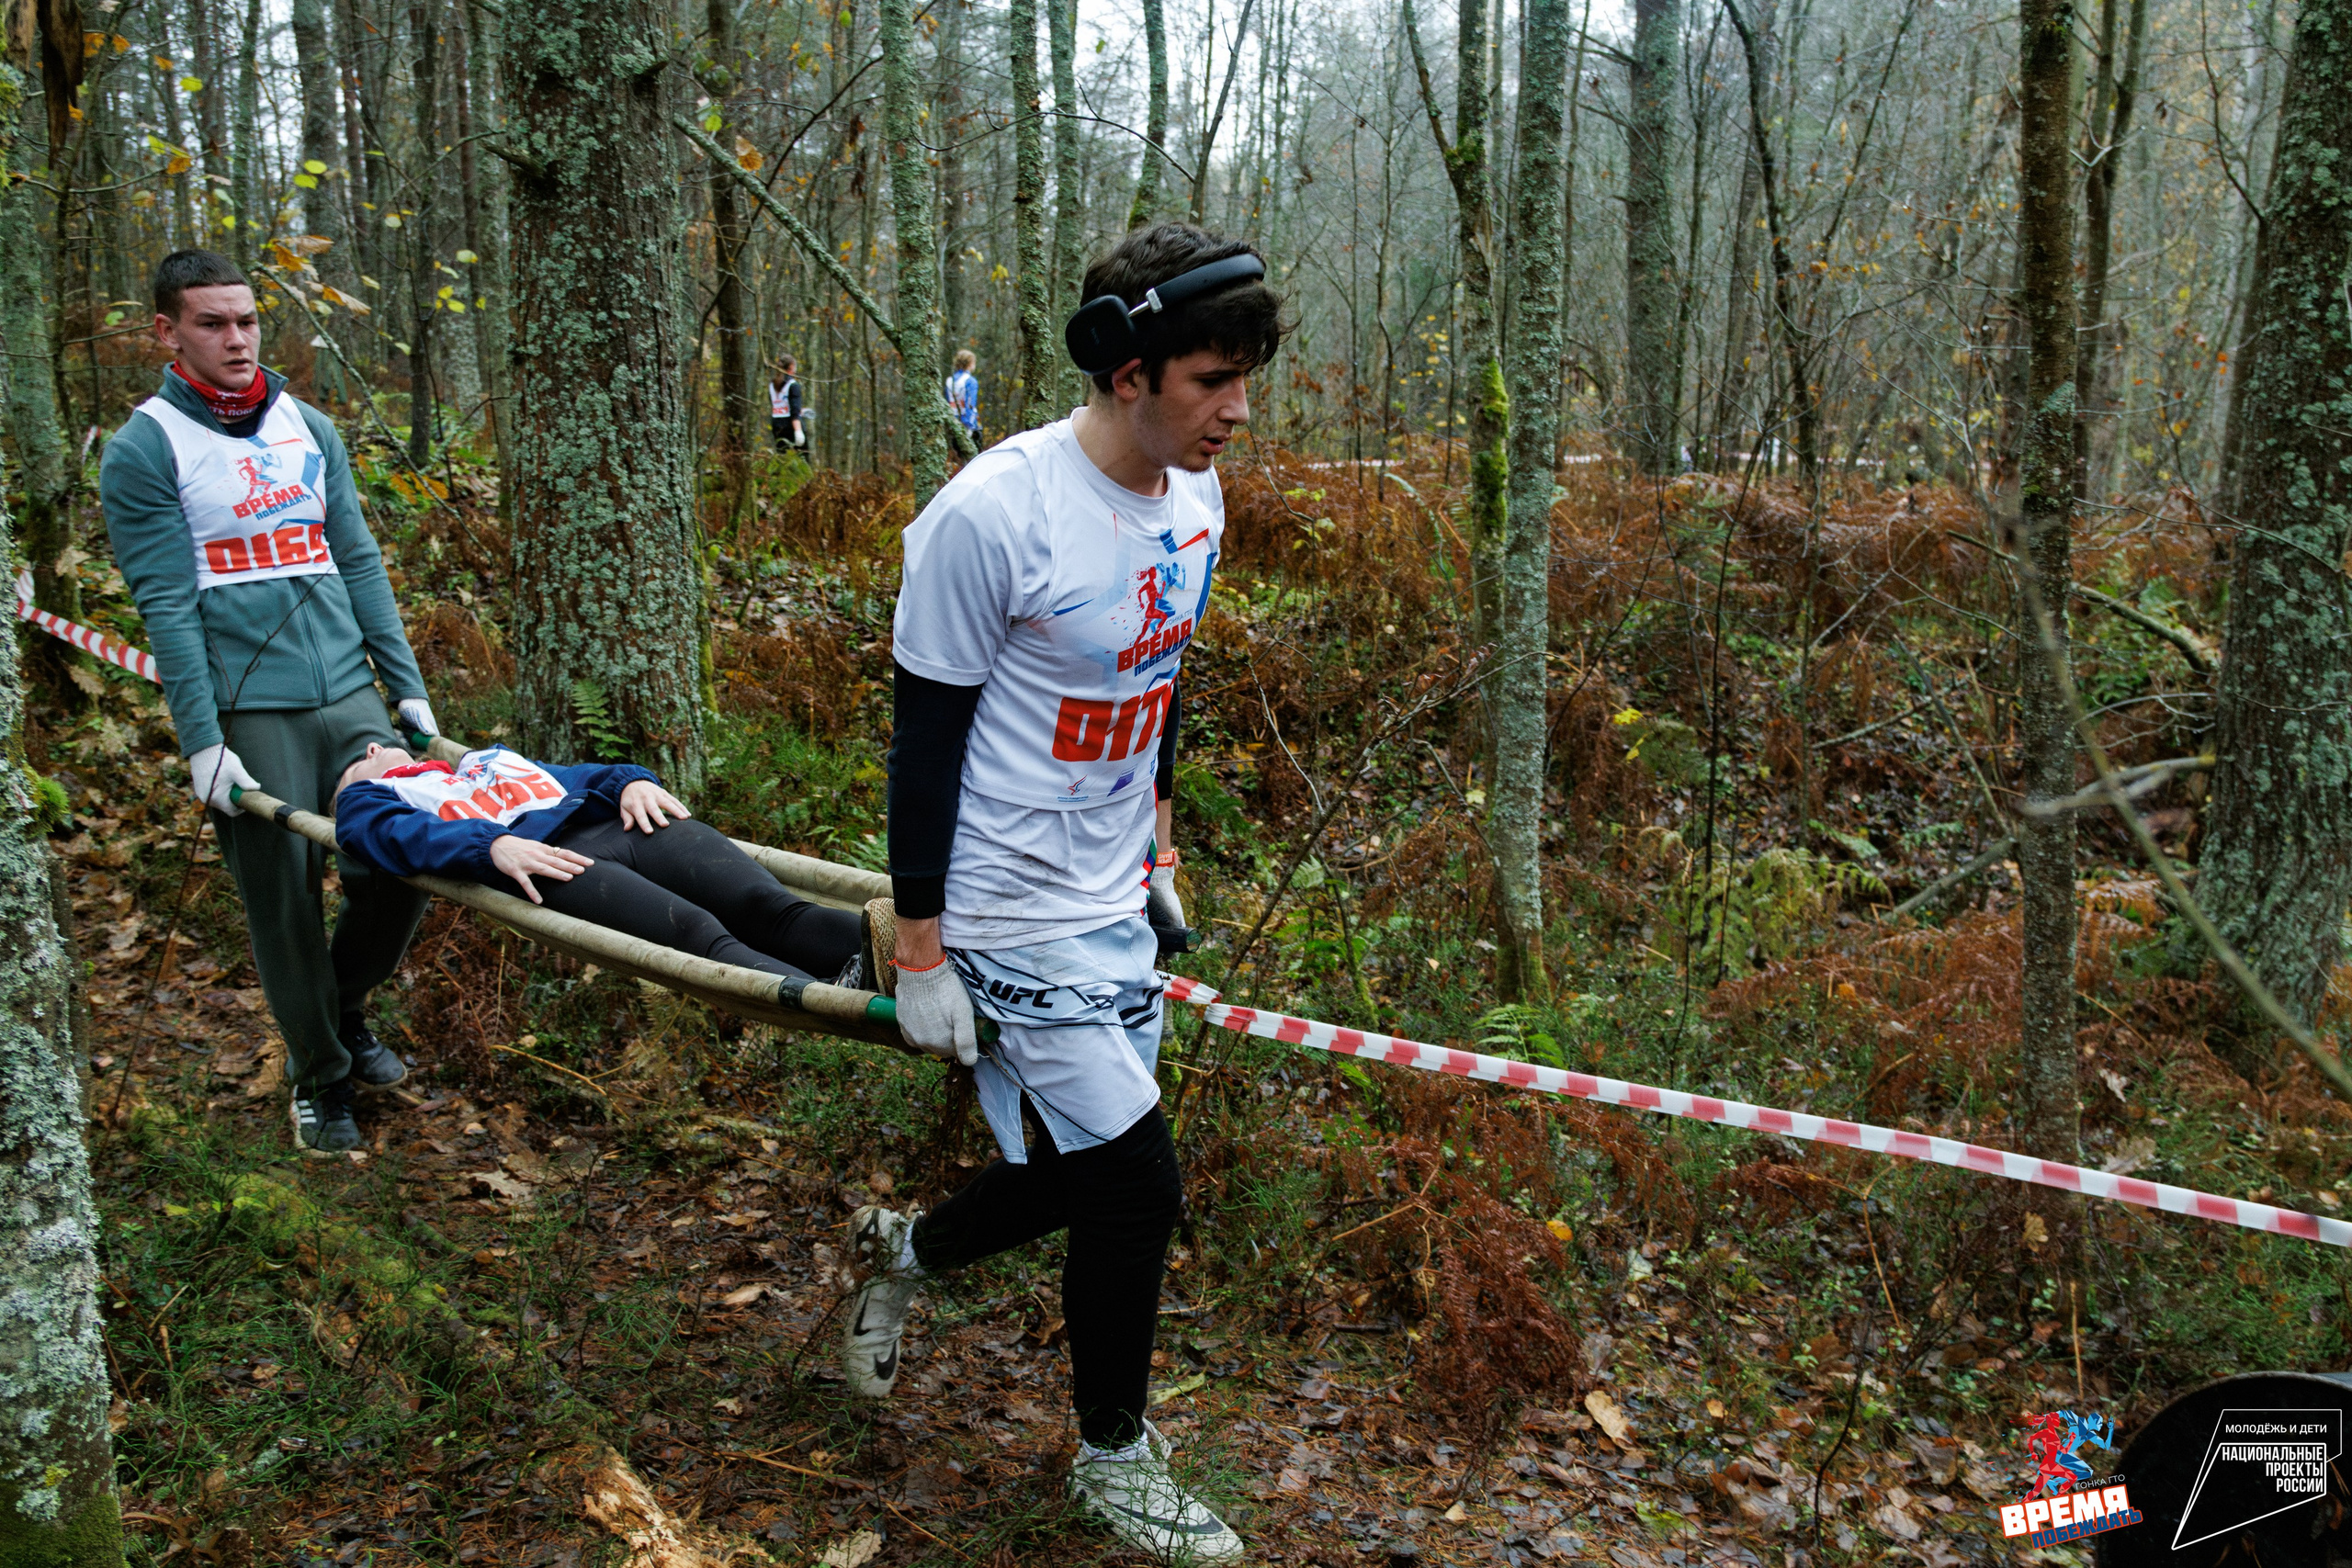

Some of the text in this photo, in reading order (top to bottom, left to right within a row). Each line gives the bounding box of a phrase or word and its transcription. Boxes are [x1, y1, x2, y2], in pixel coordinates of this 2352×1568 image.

[232, 484, 304, 519] ВРЕМЯ
[254, 493, 312, 521] ПОБЕЖДАТЬ
[1117, 617, 1193, 672] ВРЕМЯ
[988, 978, 1058, 1009] UFC
